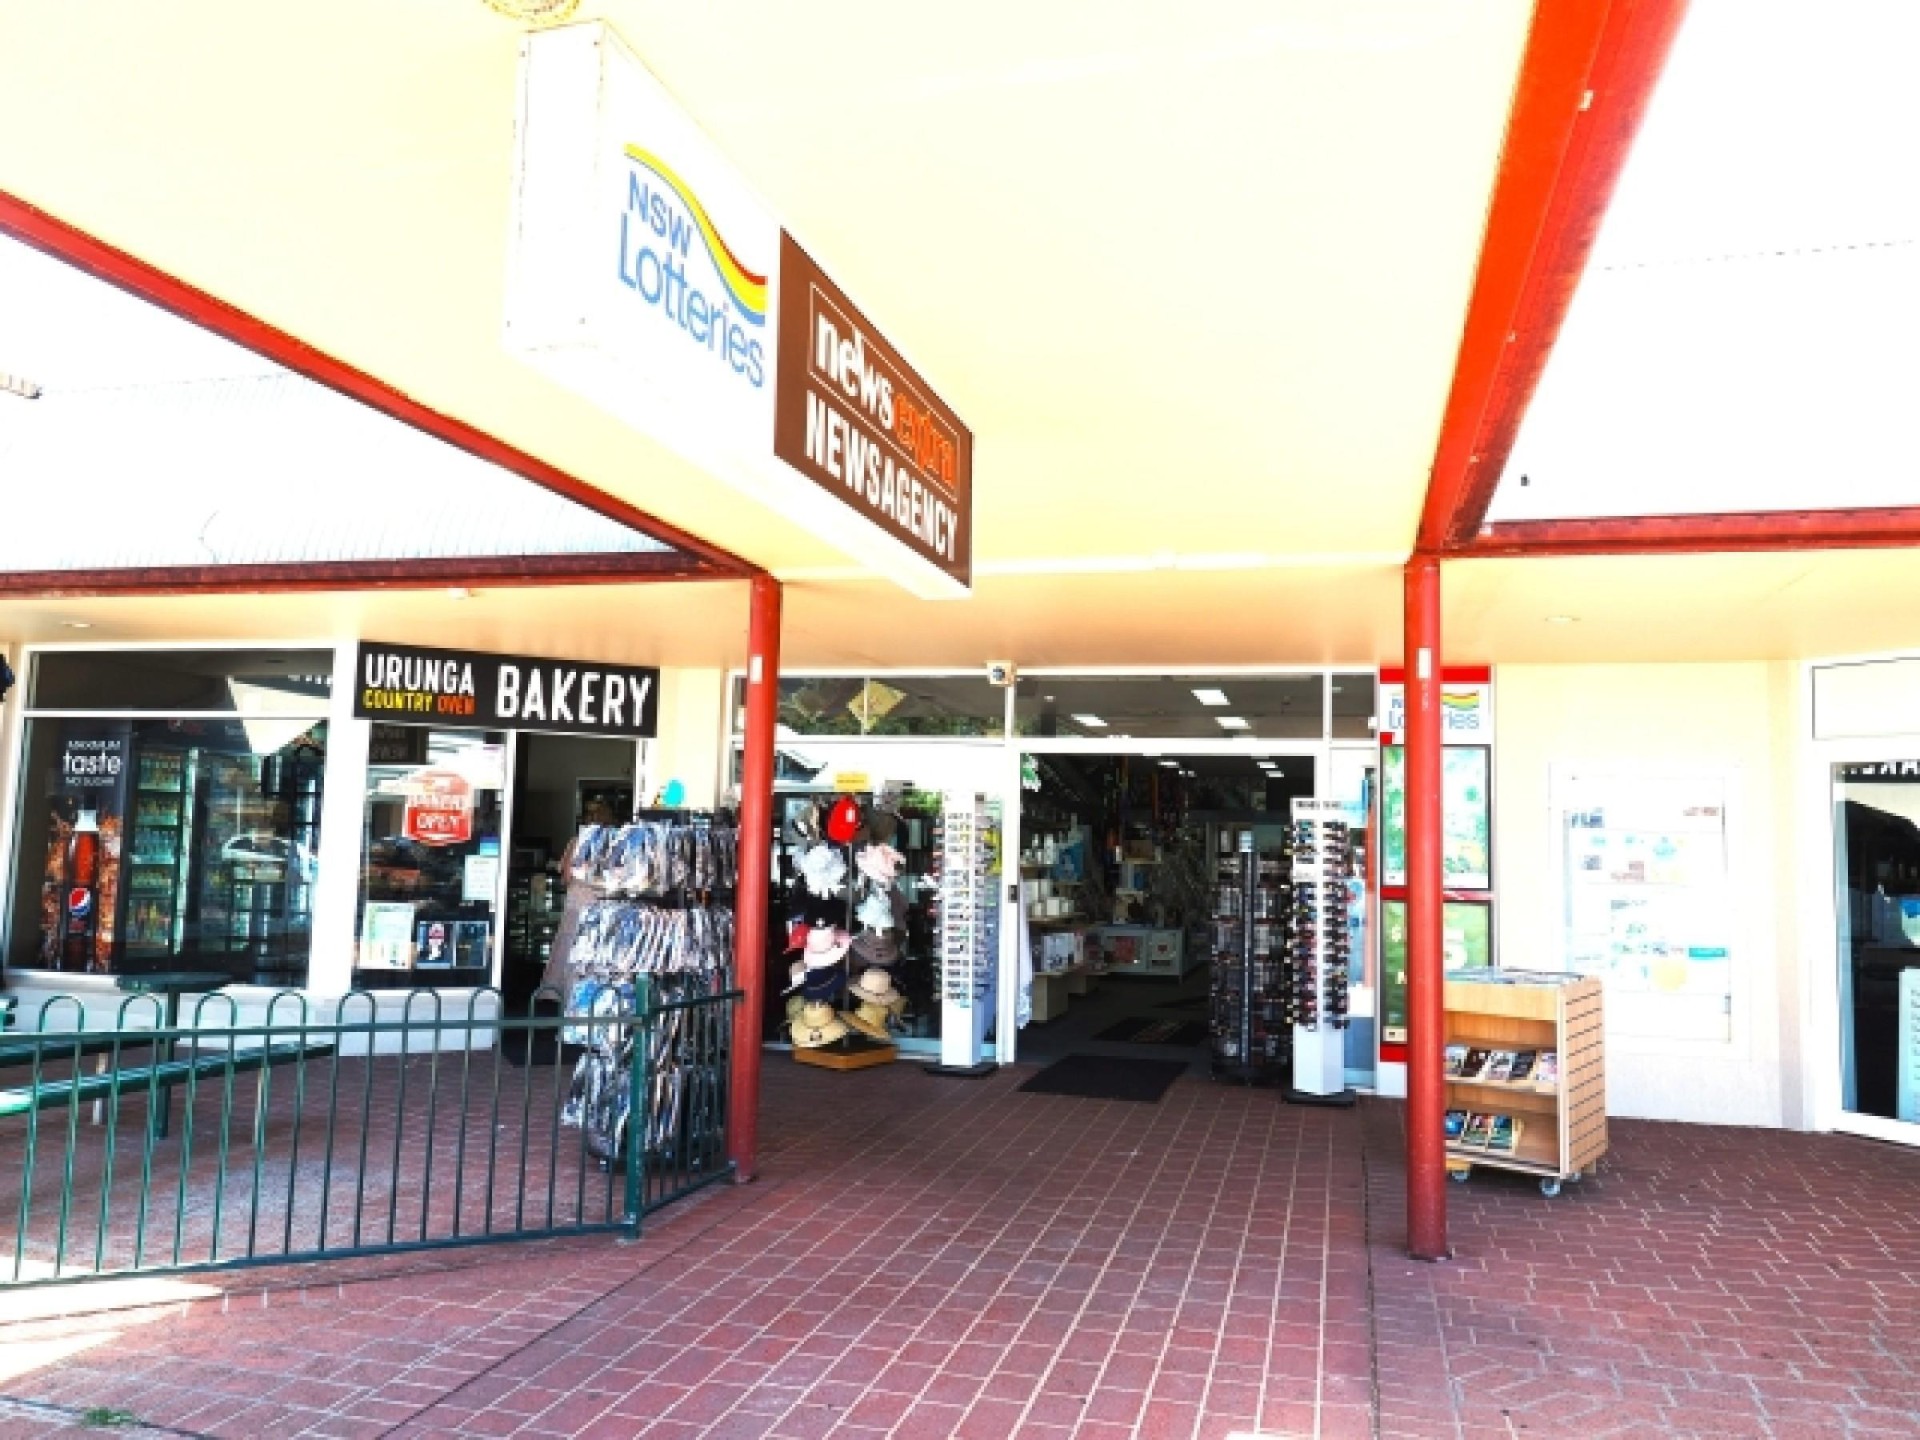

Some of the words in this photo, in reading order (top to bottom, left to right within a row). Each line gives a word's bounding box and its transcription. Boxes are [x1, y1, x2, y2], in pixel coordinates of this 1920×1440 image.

[628, 170, 691, 258] NSW
[618, 212, 765, 388] Lotteries
[815, 311, 894, 430] news
[804, 389, 958, 562] NEWSAGENCY
[362, 689, 433, 712] COUNTRY
[437, 695, 475, 715] OVEN
[365, 653, 475, 696] URUNGA
[496, 663, 652, 727] BAKERY
[63, 749, 121, 775] taste
